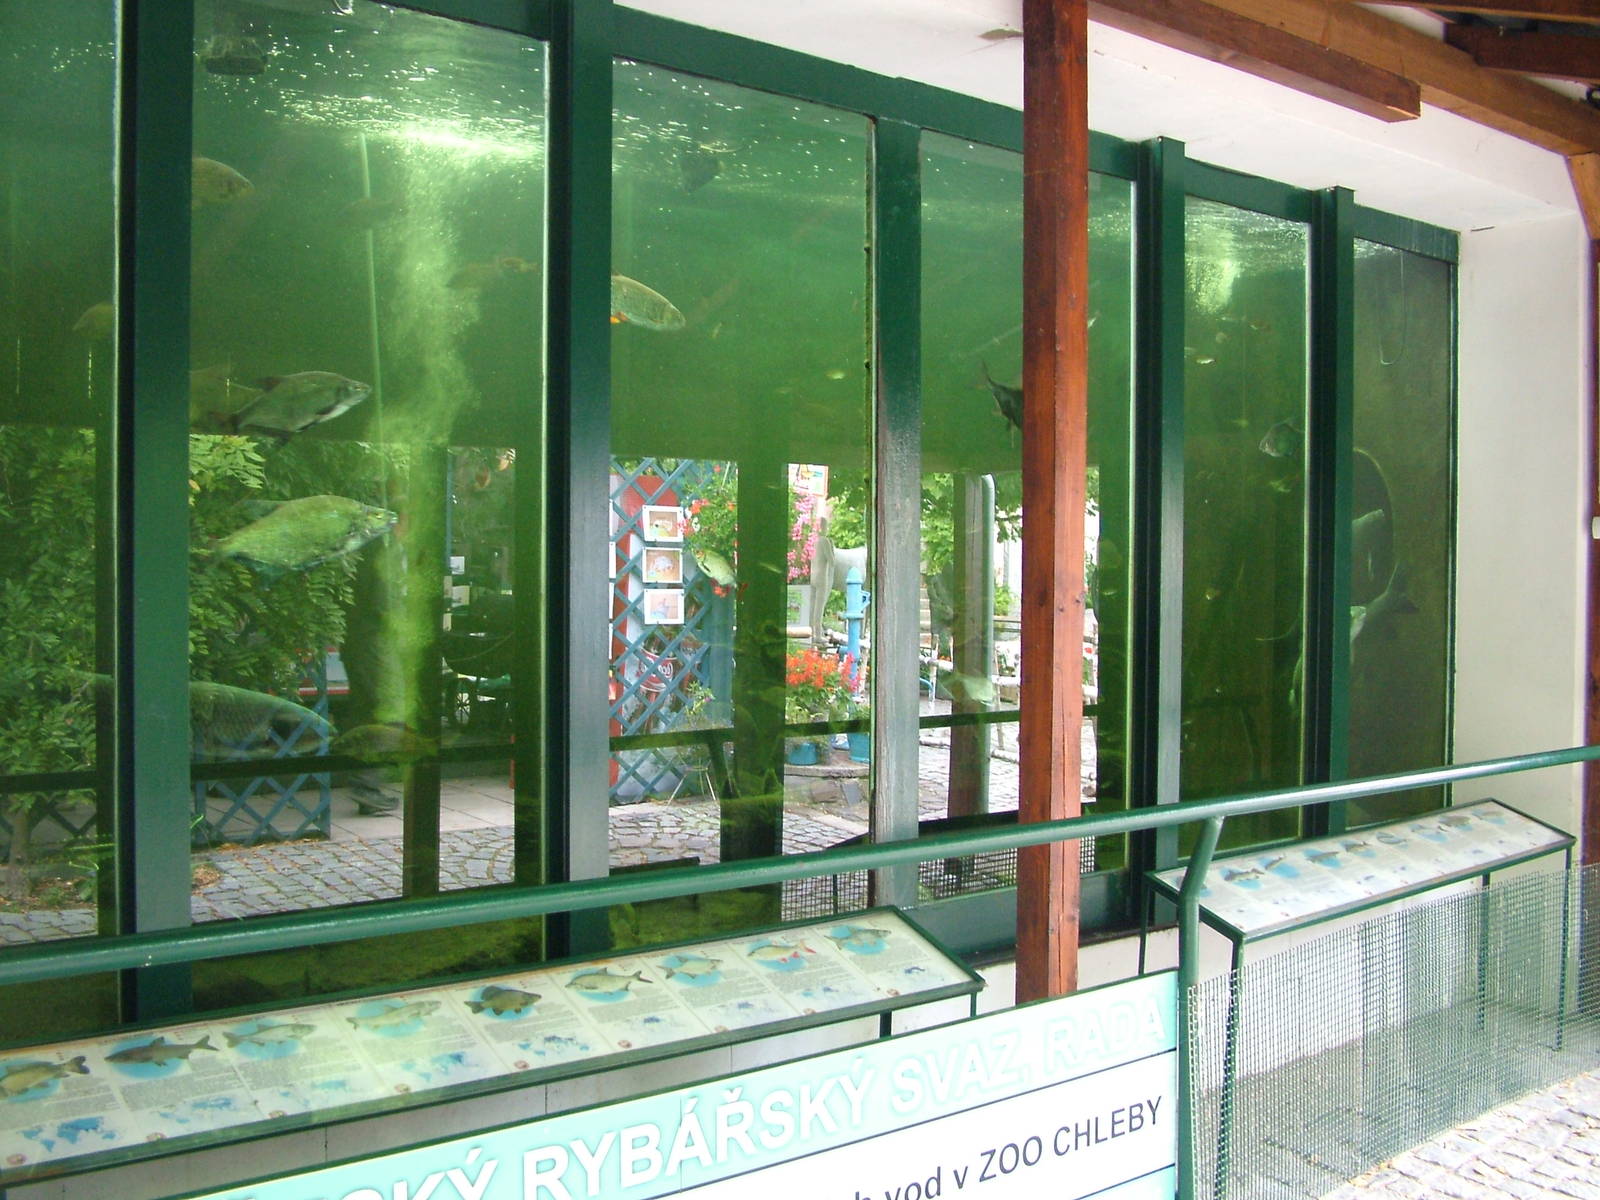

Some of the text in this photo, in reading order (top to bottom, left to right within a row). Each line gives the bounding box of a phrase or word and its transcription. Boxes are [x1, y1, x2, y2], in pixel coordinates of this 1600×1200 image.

[523, 1056, 874, 1200] RYBÁŘSKÝ
[1045, 995, 1166, 1074] RADA
[953, 1166, 968, 1189] v
[979, 1135, 1043, 1182] ZOO
[1053, 1096, 1162, 1157] CHLEBY
